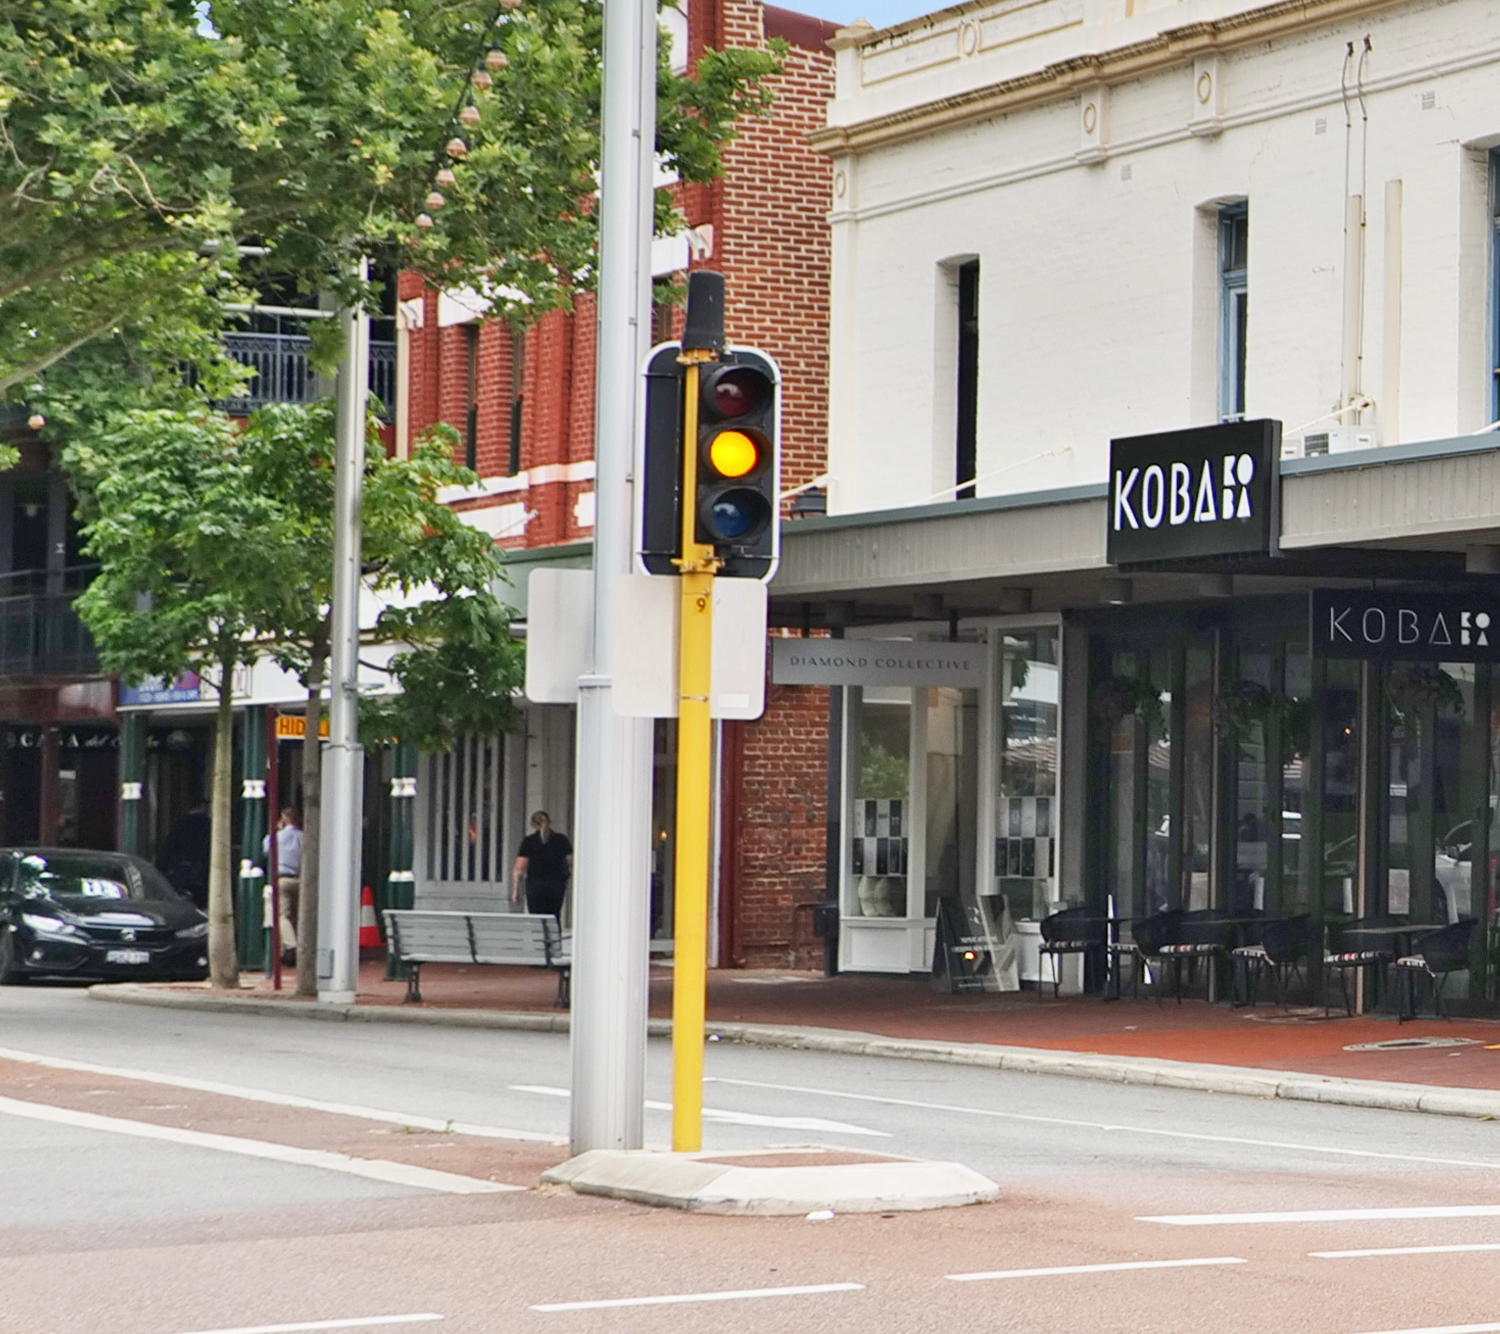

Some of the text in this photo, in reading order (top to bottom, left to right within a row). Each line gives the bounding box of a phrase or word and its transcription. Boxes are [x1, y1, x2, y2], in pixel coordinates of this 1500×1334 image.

[1114, 459, 1218, 532] KOBA
[696, 597, 707, 613] 9
[1330, 606, 1452, 644] KOBA
[790, 655, 970, 670] DIAMOND COLLECTIVE
